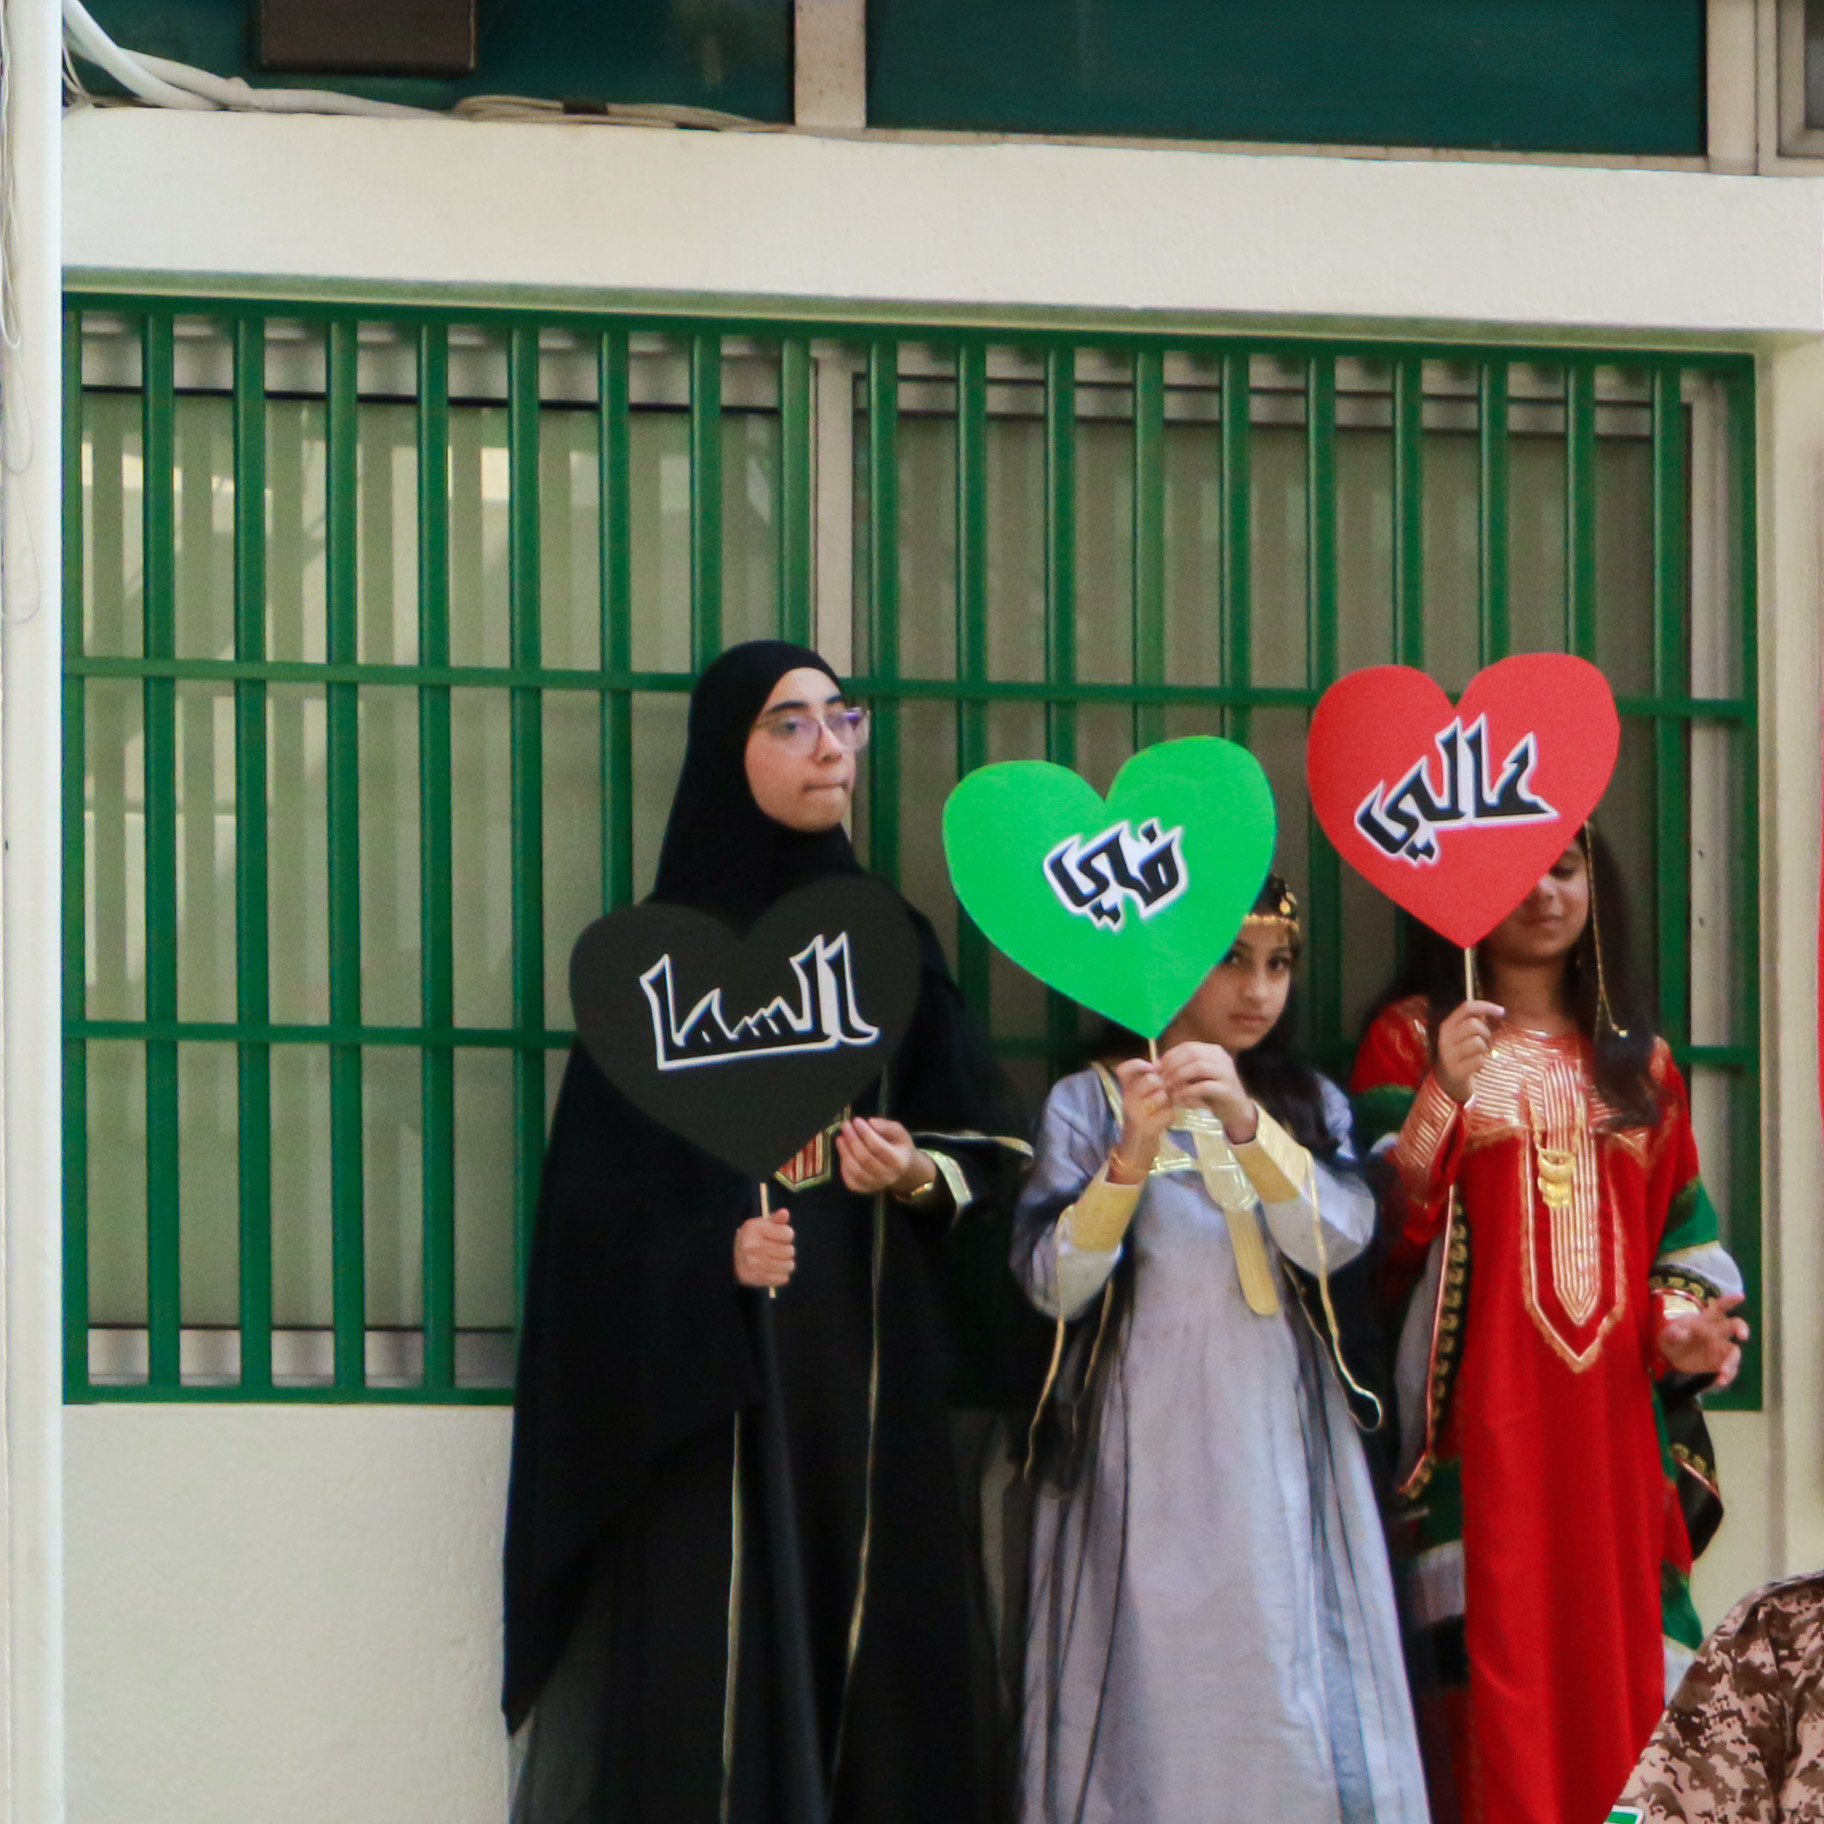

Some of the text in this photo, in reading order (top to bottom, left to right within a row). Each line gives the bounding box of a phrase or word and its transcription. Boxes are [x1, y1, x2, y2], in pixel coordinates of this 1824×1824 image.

[1355, 712, 1560, 867] عالي
[1043, 817, 1189, 933] في
[640, 931, 880, 1071] السما
